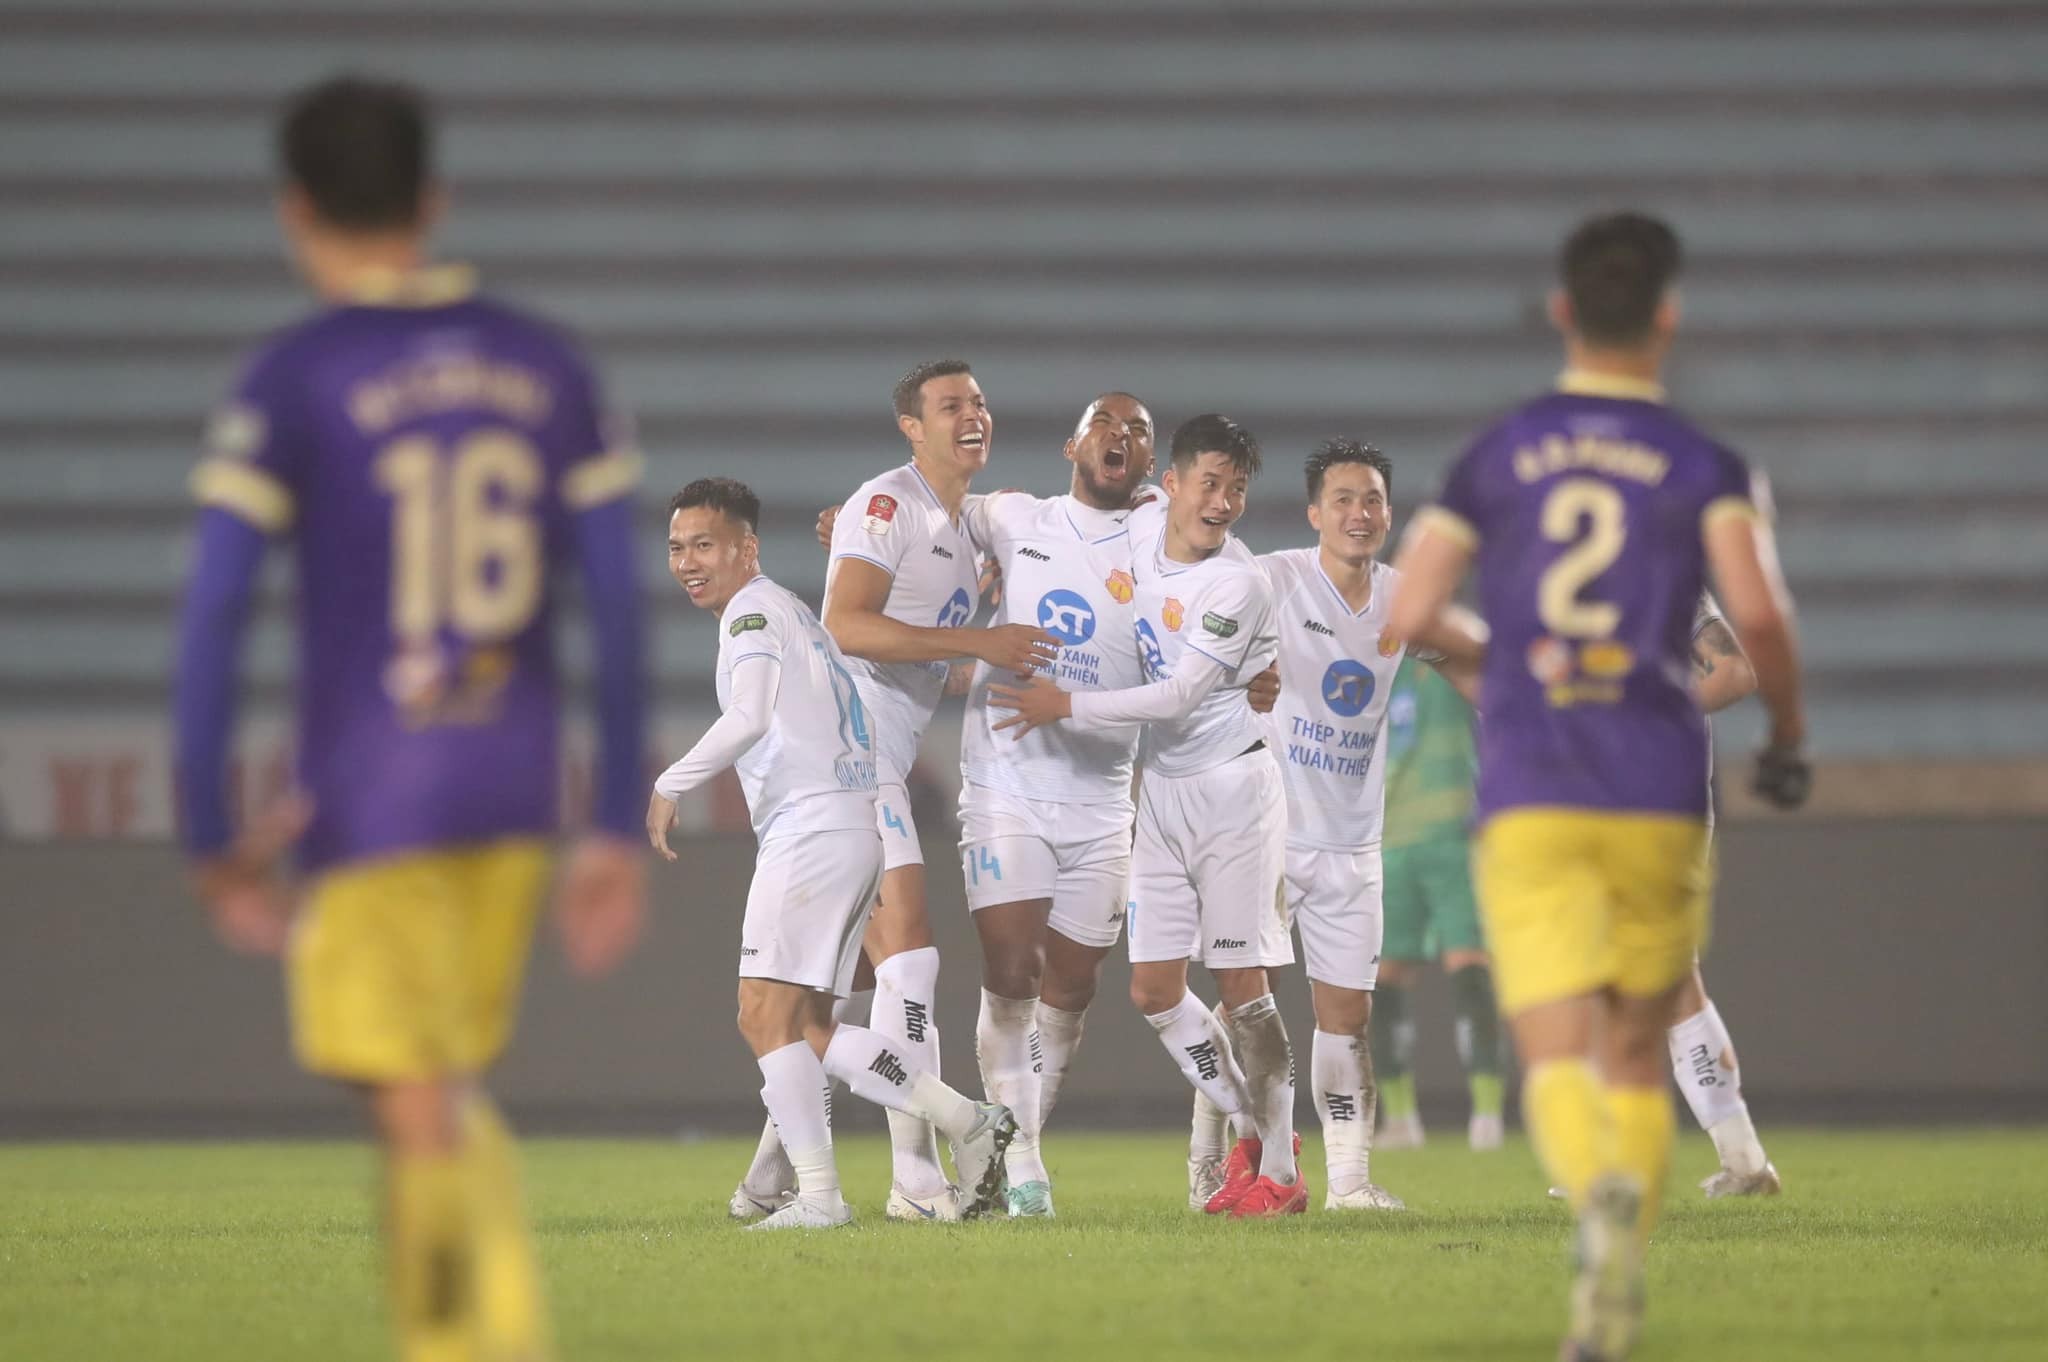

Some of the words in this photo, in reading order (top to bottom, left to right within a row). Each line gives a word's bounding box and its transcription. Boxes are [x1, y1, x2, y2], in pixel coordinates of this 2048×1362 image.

[375, 430, 545, 641] 16
[1017, 547, 1051, 562] Mitre
[1538, 477, 1626, 638] 2
[1303, 620, 1336, 637] Mitre
[1063, 648, 1100, 669] XANH
[1292, 716, 1335, 743] THÉP
[1288, 744, 1333, 772] XUÂN
[883, 805, 908, 839] 4
[969, 846, 1002, 886] 14
[1212, 938, 1247, 949] Mitre
[904, 998, 928, 1043] Mitre
[868, 1049, 907, 1086] Mitre
[1184, 1040, 1219, 1081] Mitre
[1688, 1044, 1717, 1087] mitre
